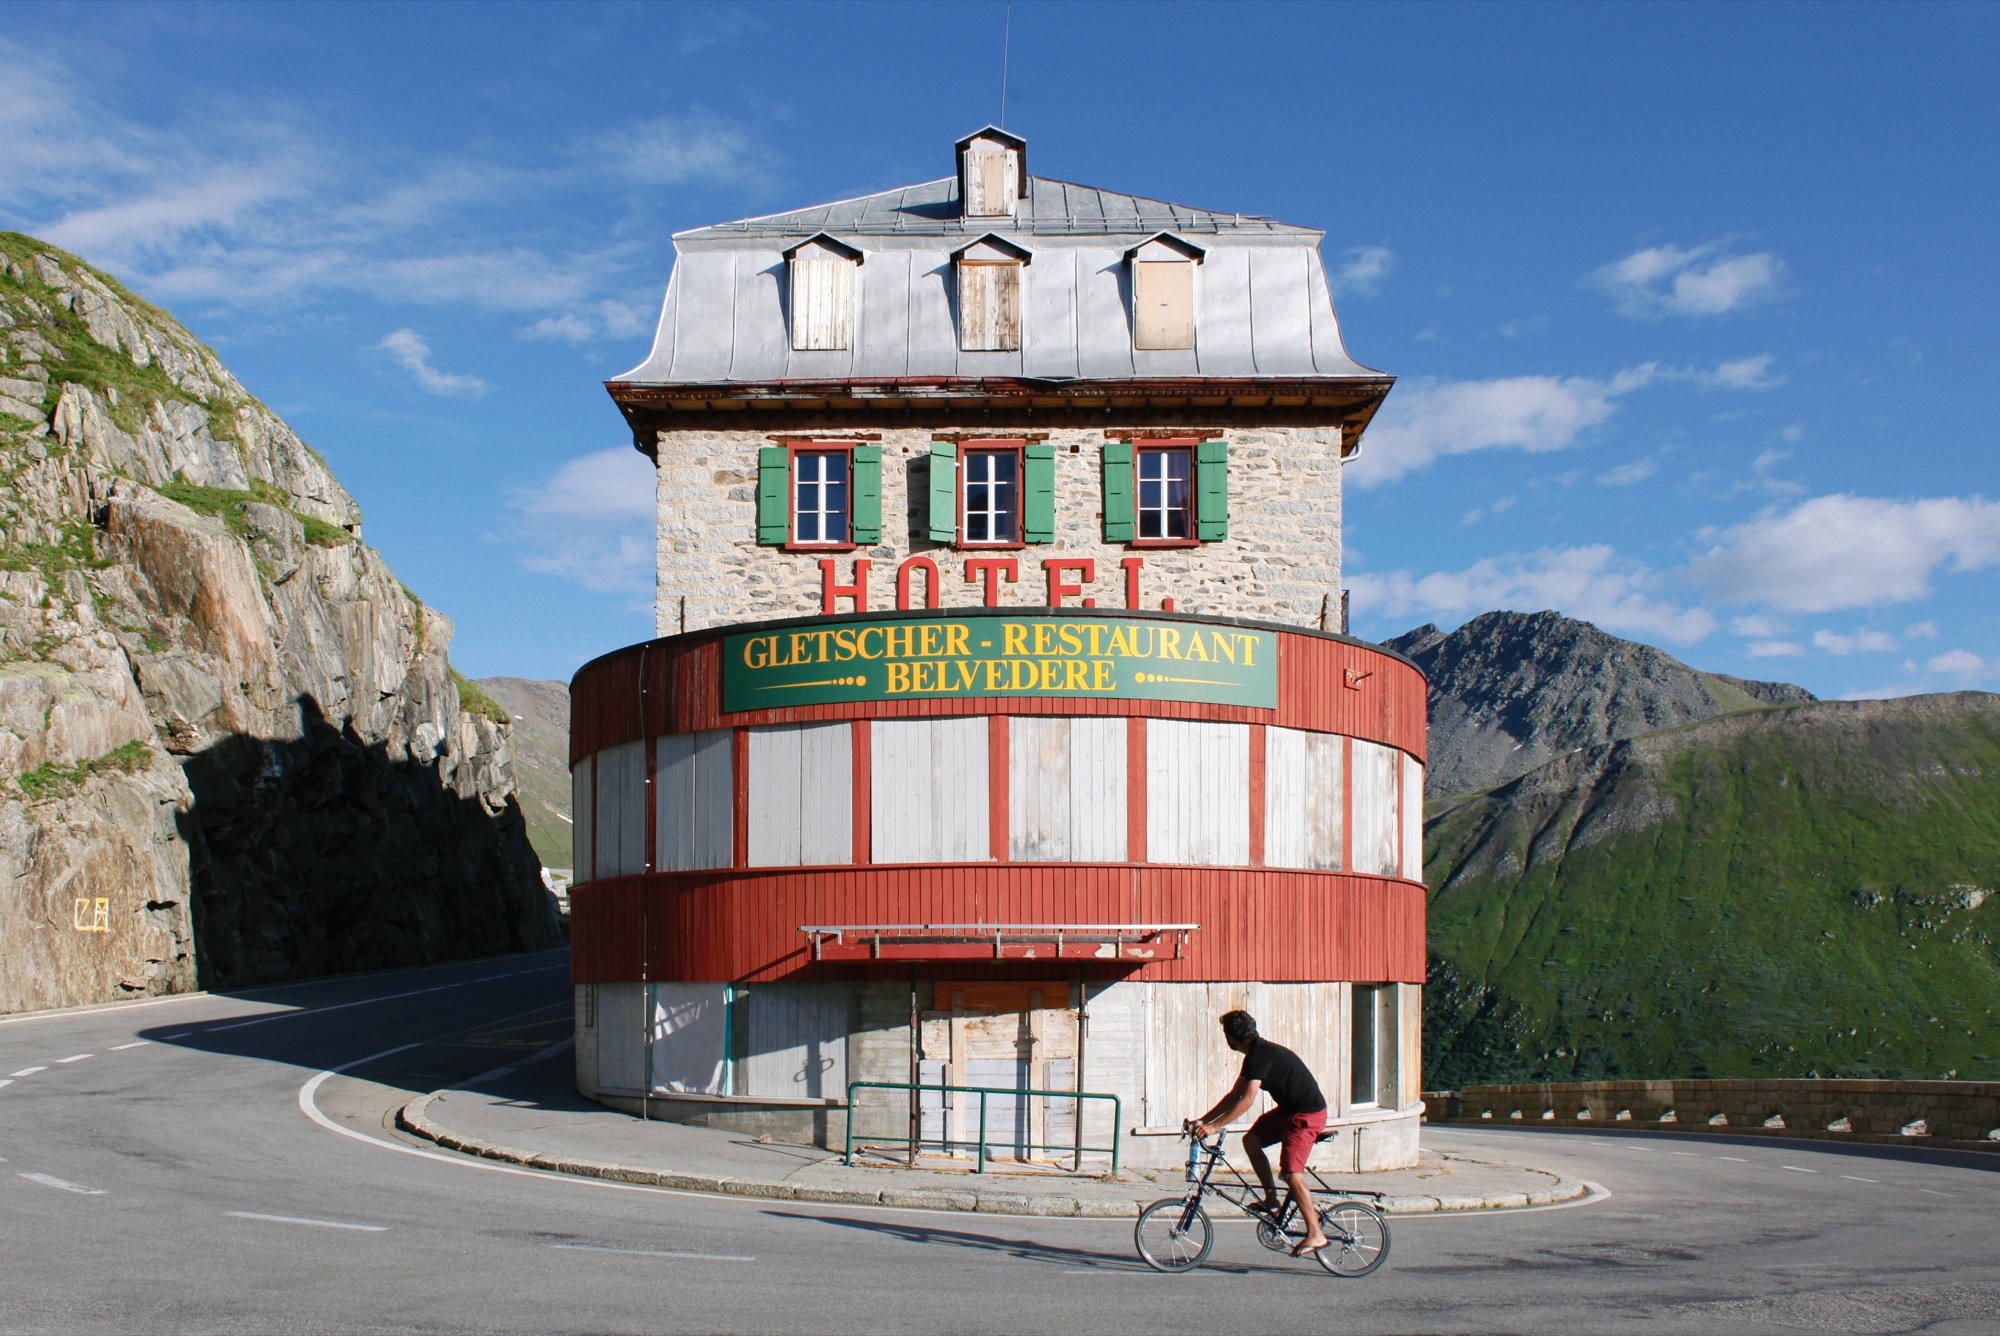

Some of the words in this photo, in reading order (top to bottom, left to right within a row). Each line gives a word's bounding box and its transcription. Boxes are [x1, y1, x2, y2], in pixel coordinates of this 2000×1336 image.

[819, 556, 1174, 616] HOTEL
[743, 624, 972, 669] GLETSCHER
[1002, 623, 1260, 667] RESTAURANT
[885, 660, 1117, 694] BELVEDERE
